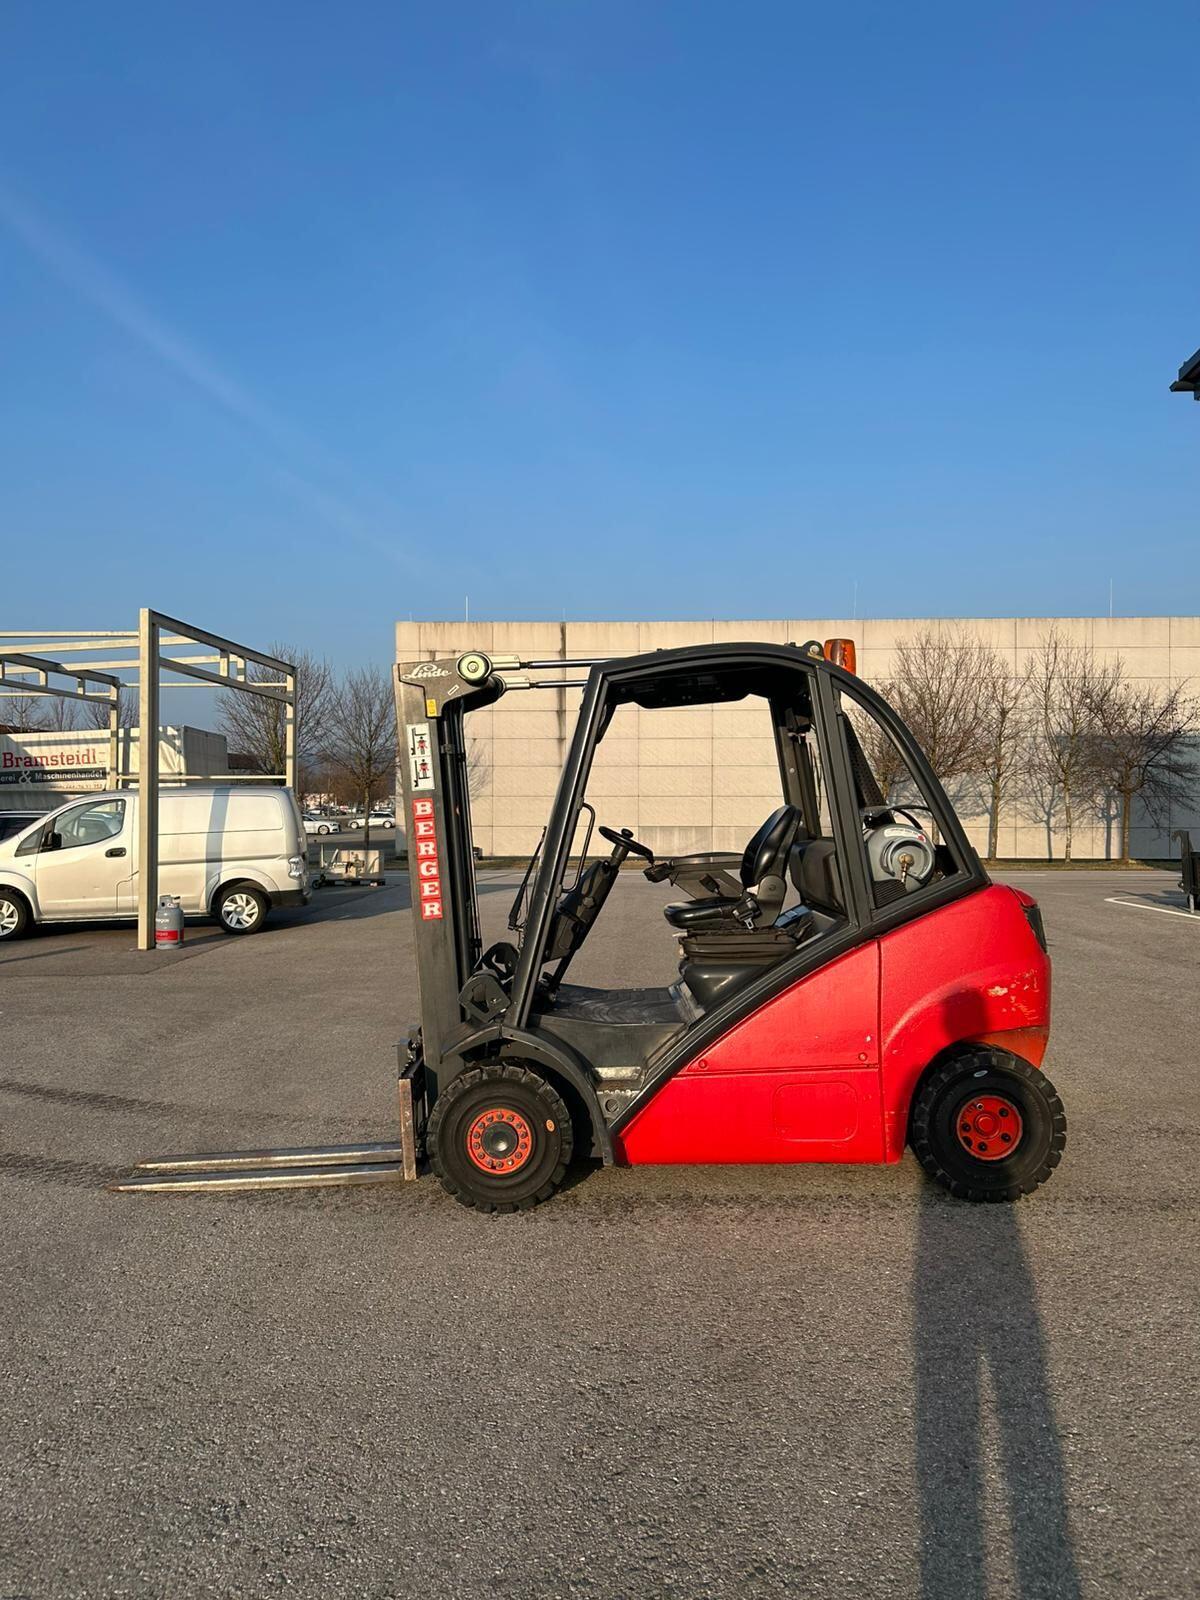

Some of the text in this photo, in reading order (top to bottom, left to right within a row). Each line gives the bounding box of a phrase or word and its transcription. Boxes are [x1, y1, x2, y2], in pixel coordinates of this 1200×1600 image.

[402, 663, 452, 679] Linde
[2, 748, 97, 768] Bramsteidl
[18, 770, 33, 787] &
[35, 770, 103, 780] Maschinenhandel
[415, 801, 442, 917] BERGER
